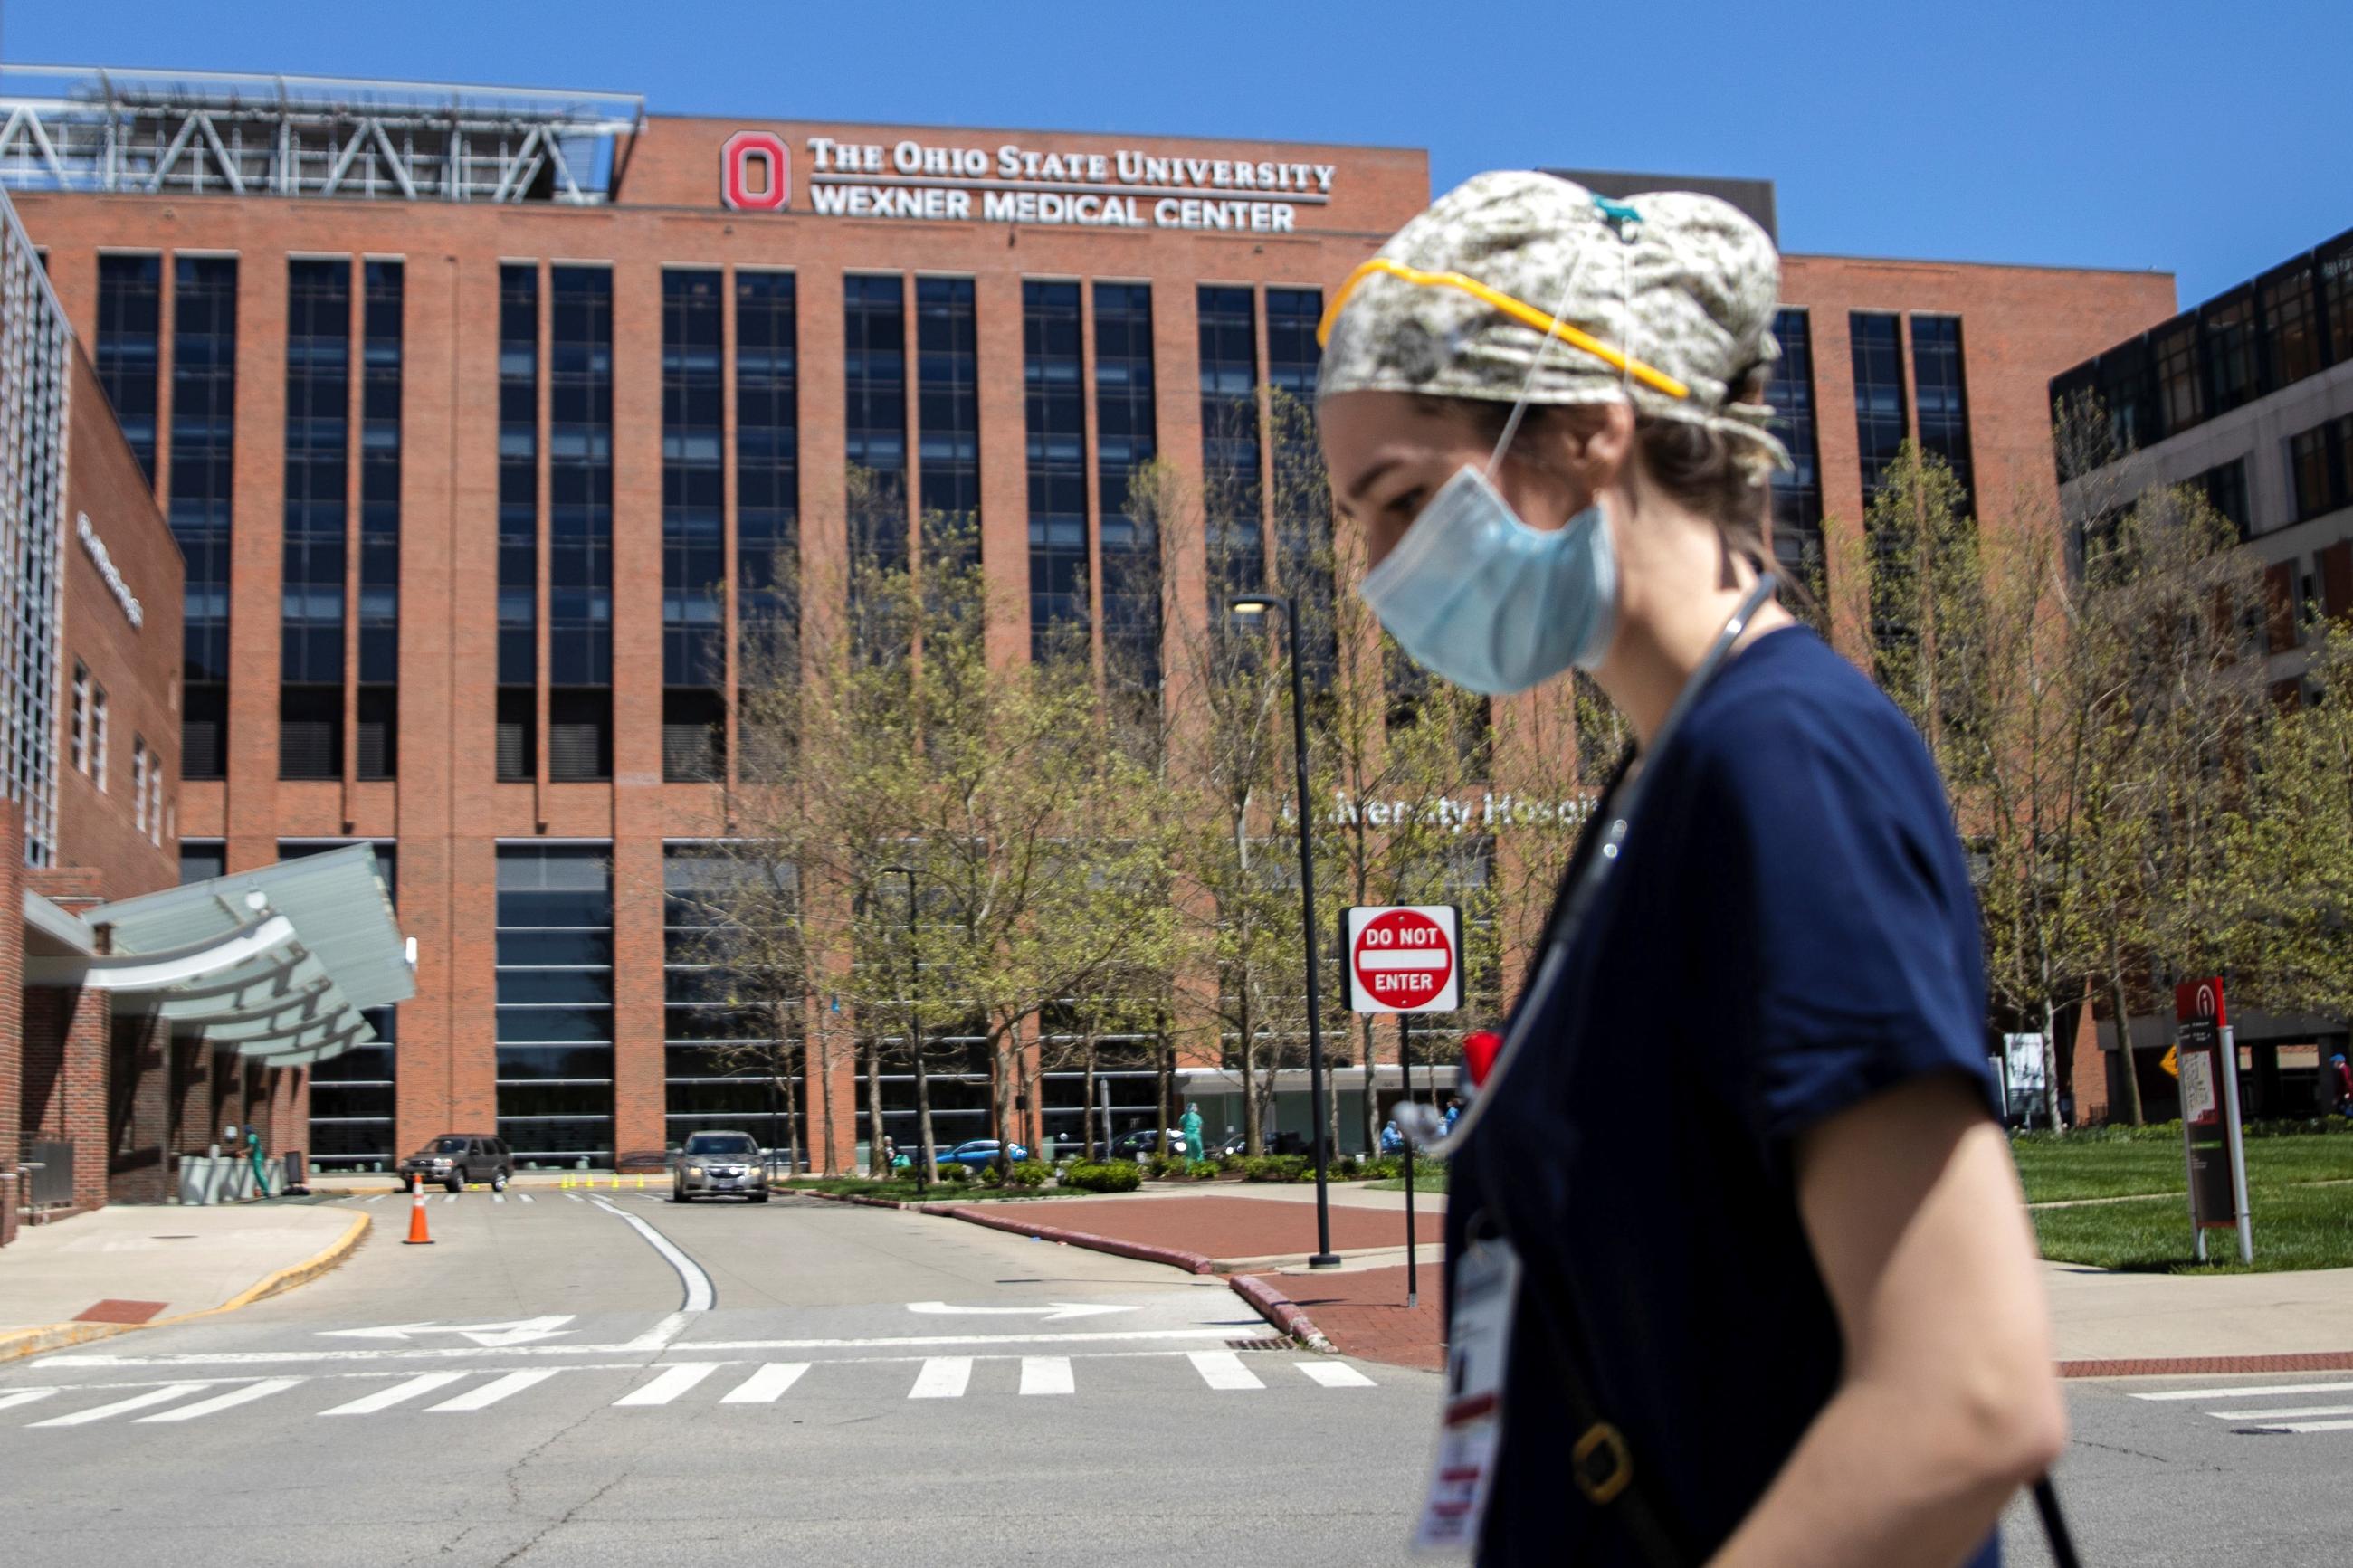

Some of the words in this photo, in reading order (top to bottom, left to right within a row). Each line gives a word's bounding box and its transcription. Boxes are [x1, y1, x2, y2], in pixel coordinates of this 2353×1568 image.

[811, 185, 972, 219] WEXNER
[984, 190, 1148, 226] MEDICAL
[1154, 197, 1296, 233] CENTER
[1366, 928, 1393, 946] DO
[1399, 927, 1438, 946] NOT
[1375, 973, 1433, 992] ENTER
